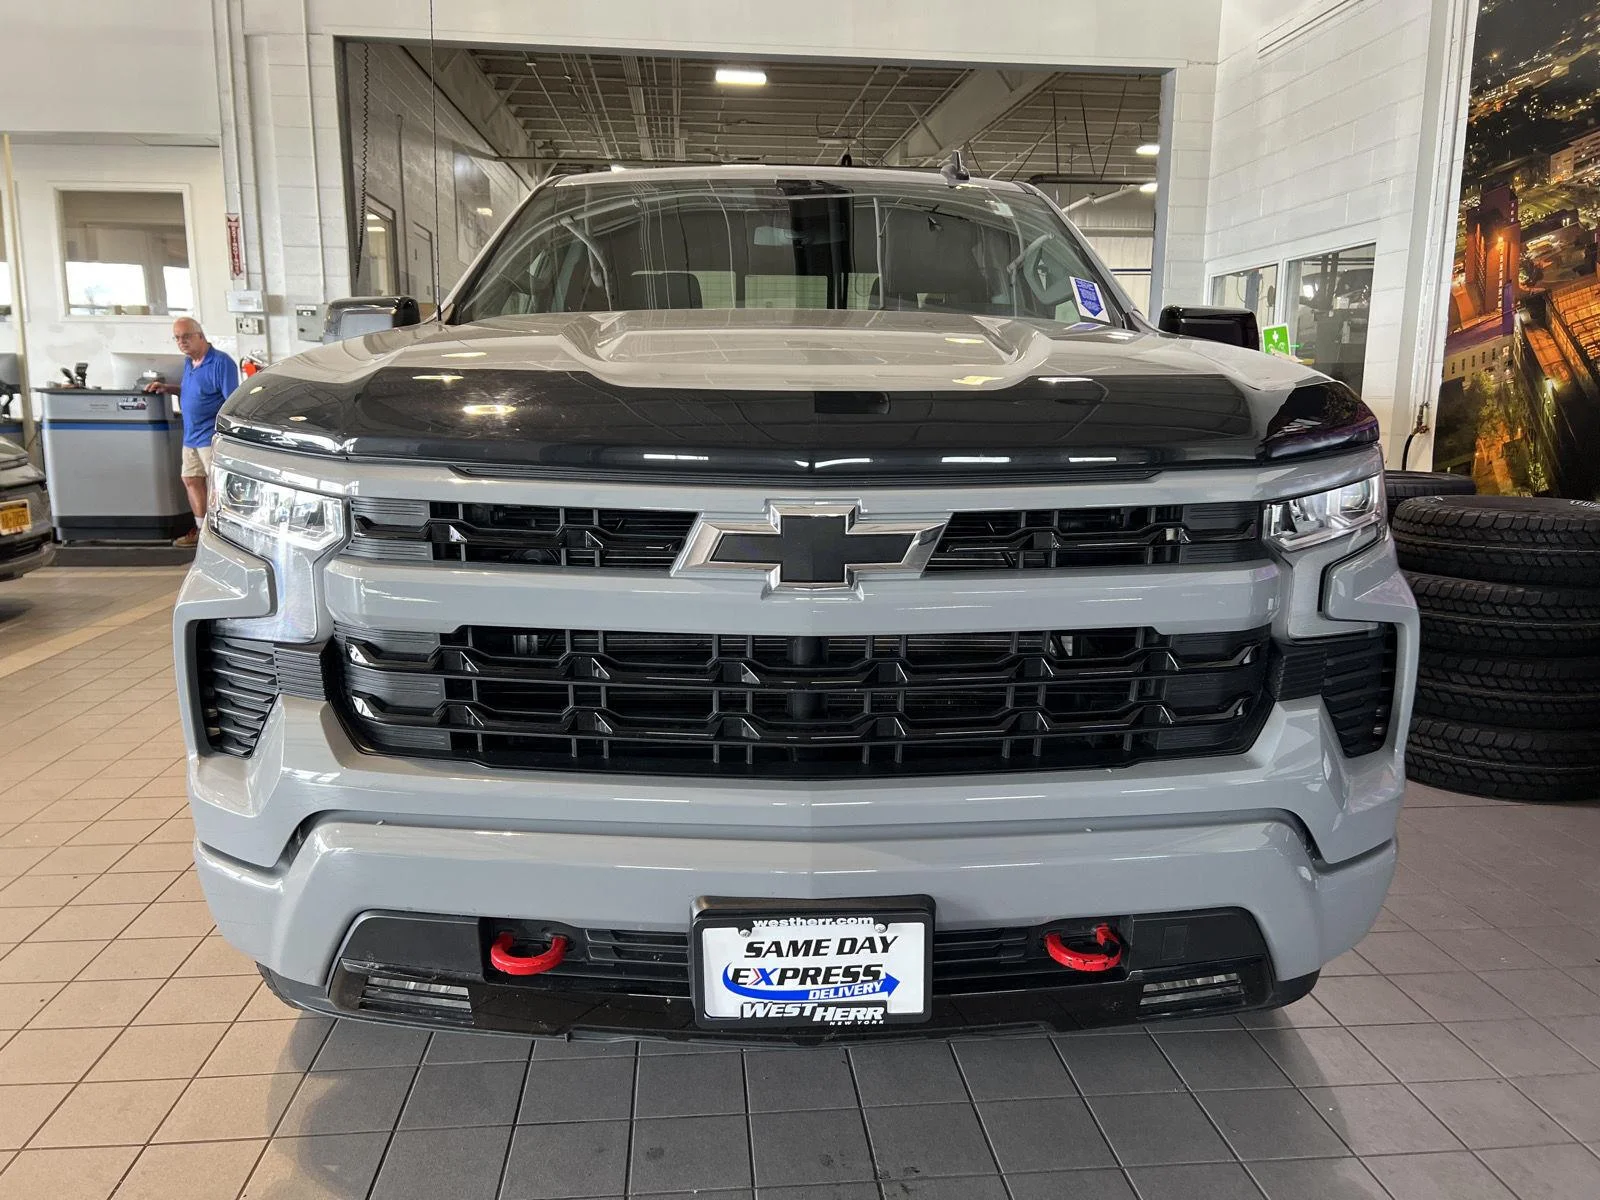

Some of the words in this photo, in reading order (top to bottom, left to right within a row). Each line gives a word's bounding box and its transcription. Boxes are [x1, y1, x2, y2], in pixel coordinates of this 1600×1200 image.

[753, 917, 874, 928] westherr.com
[744, 938, 832, 958] SAME
[836, 935, 899, 955] DAY
[731, 964, 883, 986] EXPRESS
[808, 980, 884, 1000] DELIVERY
